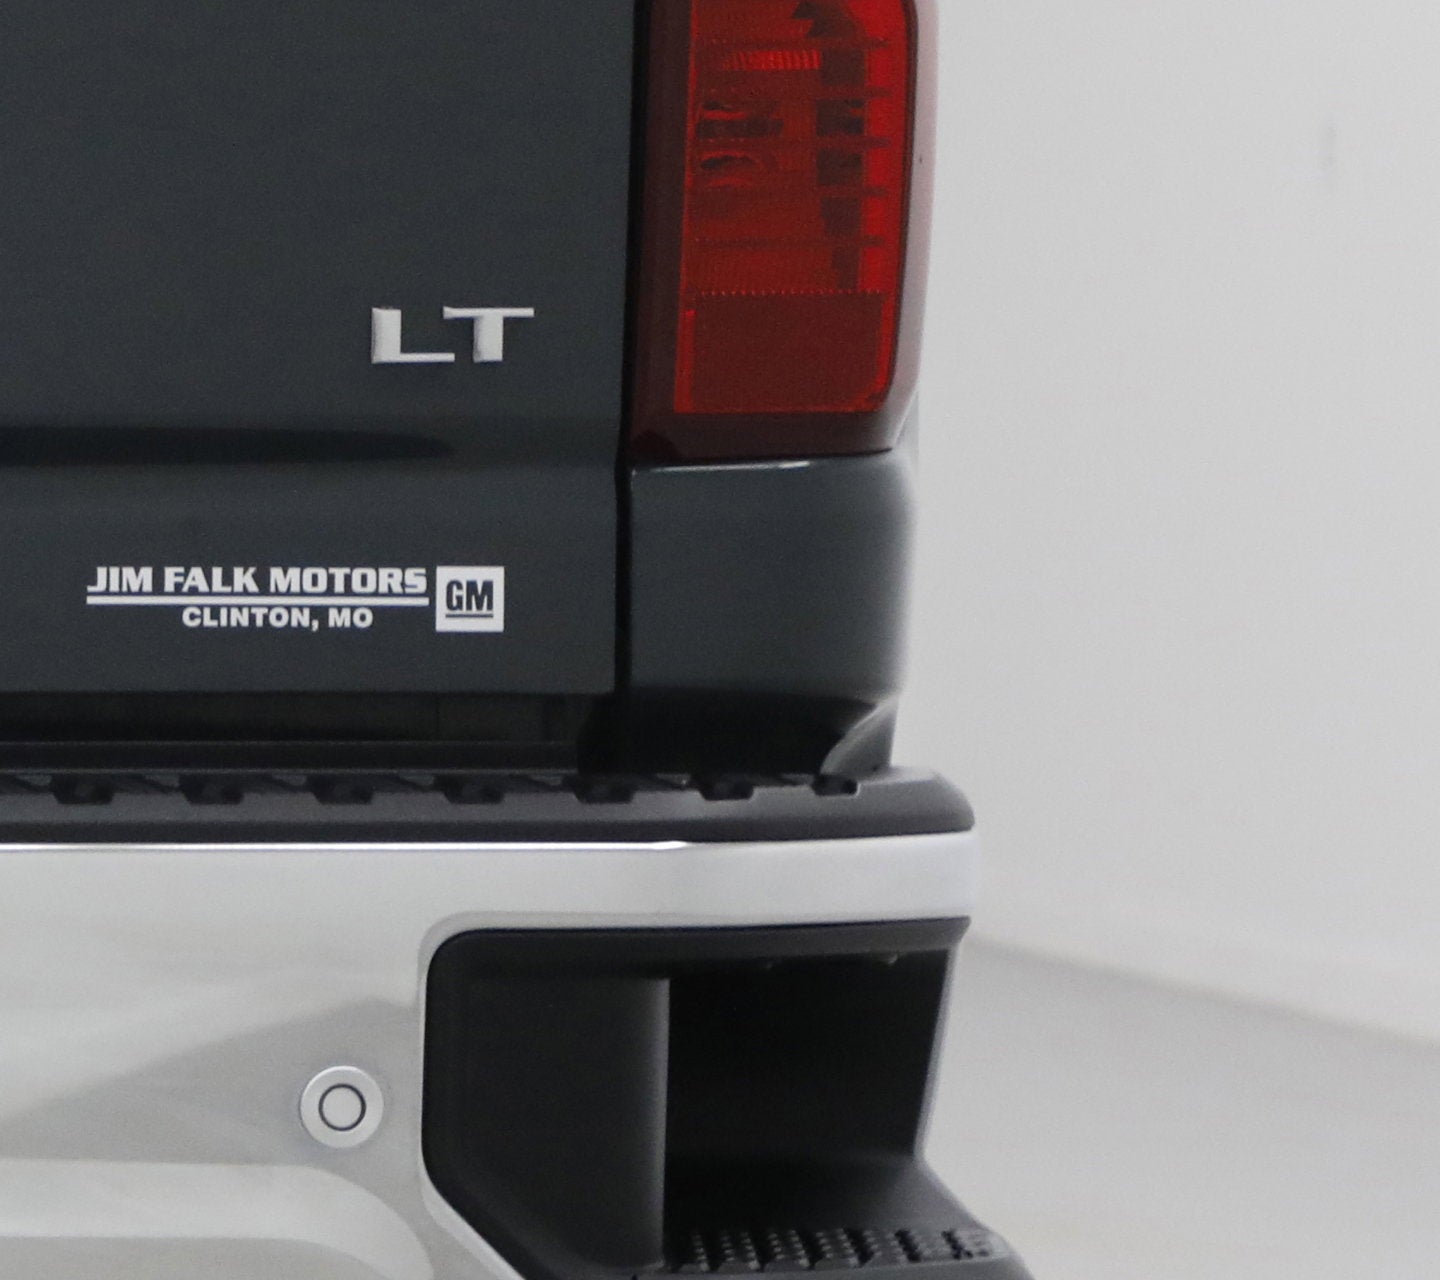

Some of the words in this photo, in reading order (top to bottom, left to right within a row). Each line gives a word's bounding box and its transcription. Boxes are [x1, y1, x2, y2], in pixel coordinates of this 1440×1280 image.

[371, 307, 534, 363] LT
[86, 566, 152, 593] JIM
[163, 566, 260, 593] FALK
[269, 566, 428, 594] MOTORS
[445, 580, 494, 612] GM
[182, 606, 319, 632] CLINTON,
[328, 606, 374, 629] MO
